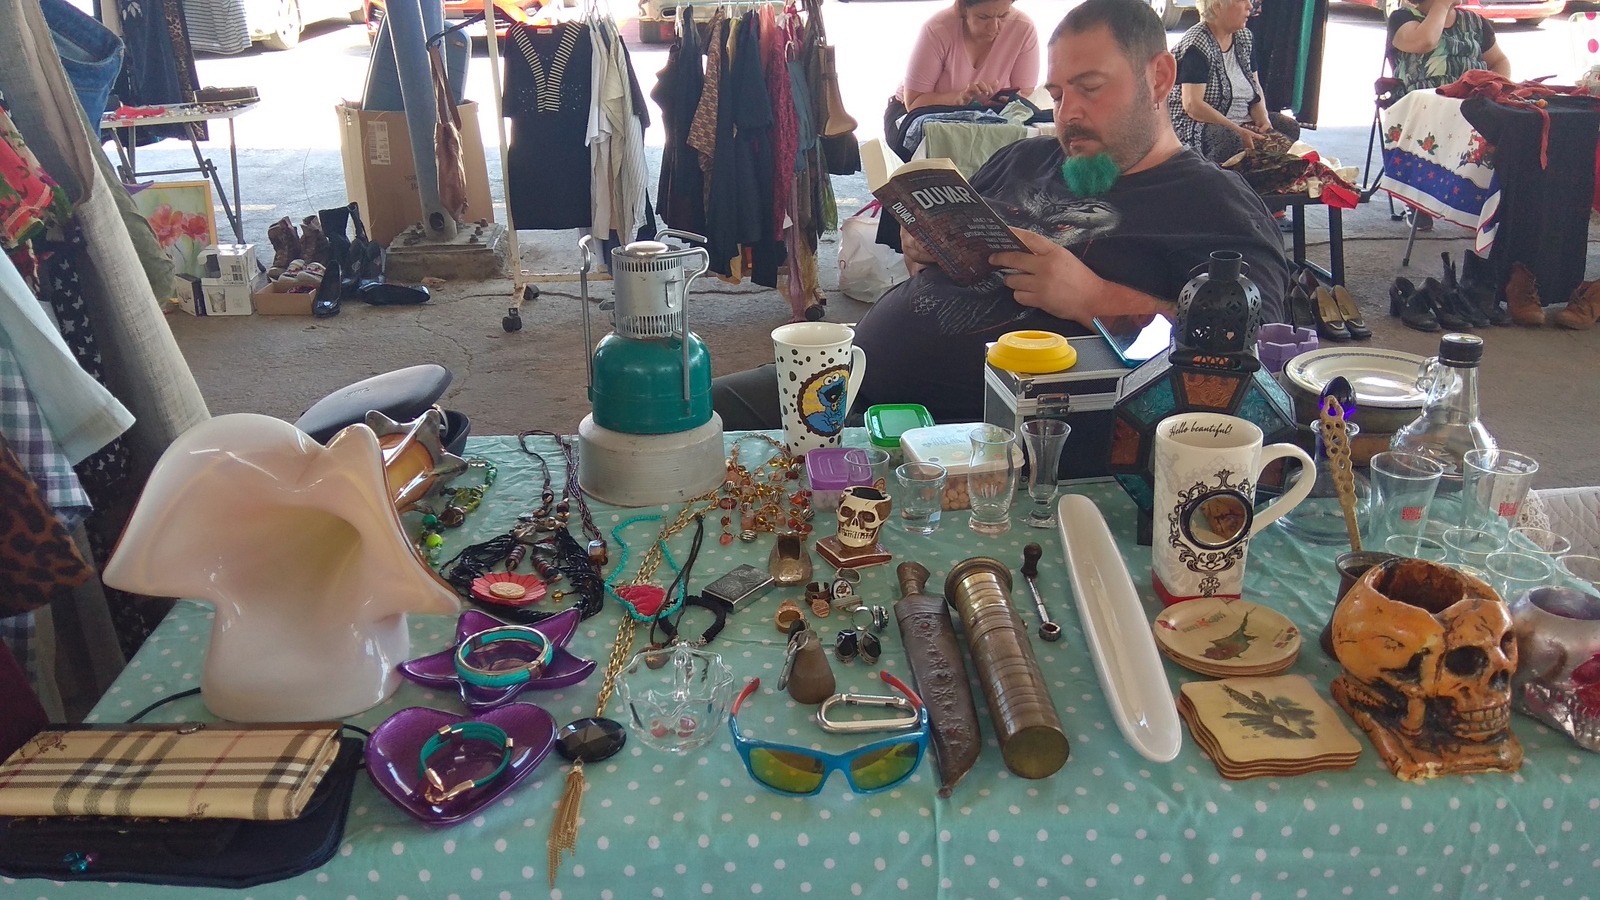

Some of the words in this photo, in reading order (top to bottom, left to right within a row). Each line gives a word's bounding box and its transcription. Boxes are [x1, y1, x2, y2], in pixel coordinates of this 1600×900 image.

[911, 185, 979, 210] DUVAR
[891, 201, 917, 226] DUVAR
[1169, 421, 1189, 438] Hello
[1190, 421, 1233, 438] beautiful!
